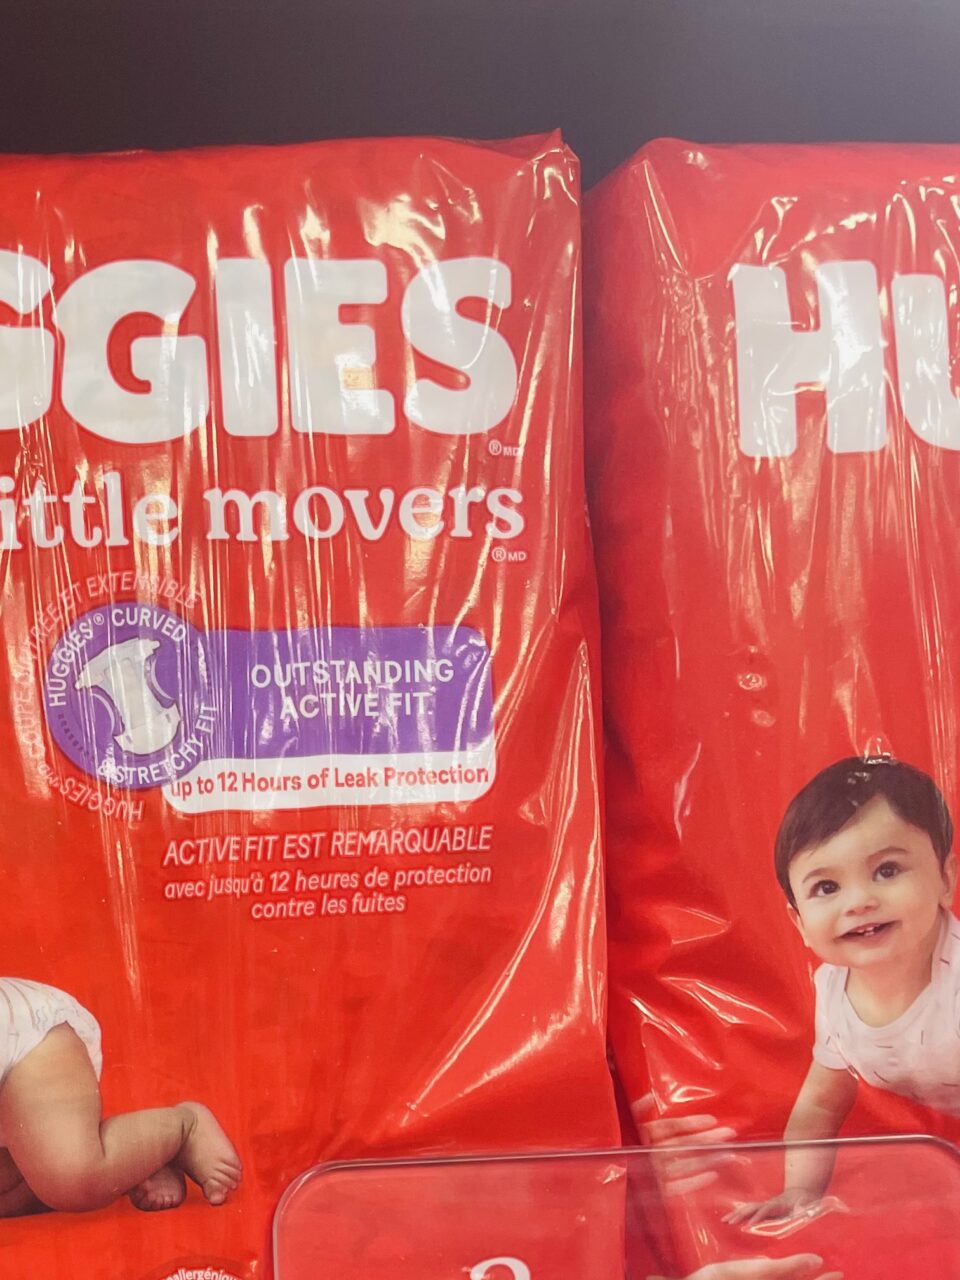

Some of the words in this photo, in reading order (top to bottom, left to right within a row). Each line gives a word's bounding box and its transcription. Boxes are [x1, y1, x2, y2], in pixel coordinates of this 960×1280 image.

[205, 481, 525, 548] movers
[87, 571, 203, 610] EXTENSIBLE
[111, 607, 187, 643] CURVED
[251, 659, 455, 689] OUTSTANDING
[280, 693, 380, 721] ACTIVE
[116, 732, 205, 786] STRETCHY
[195, 702, 218, 737] FIT
[171, 777, 192, 801] up
[196, 774, 215, 796] to
[217, 771, 238, 793] 12
[242, 770, 303, 793] Hours
[307, 767, 330, 790] of
[335, 766, 378, 789] Leak
[384, 765, 489, 788] Protection
[163, 836, 241, 866] ACTIVE
[244, 835, 279, 861] FIT
[283, 833, 326, 859] EST
[331, 826, 494, 857] REMARQUABLE
[164, 879, 204, 900] avec
[206, 873, 265, 902] jusqu'à
[269, 871, 290, 893] 12
[294, 869, 359, 891] heures
[364, 866, 389, 888] de
[393, 862, 492, 891] protection
[251, 898, 316, 920] contre
[321, 892, 347, 915] les
[351, 891, 406, 915] fuites
